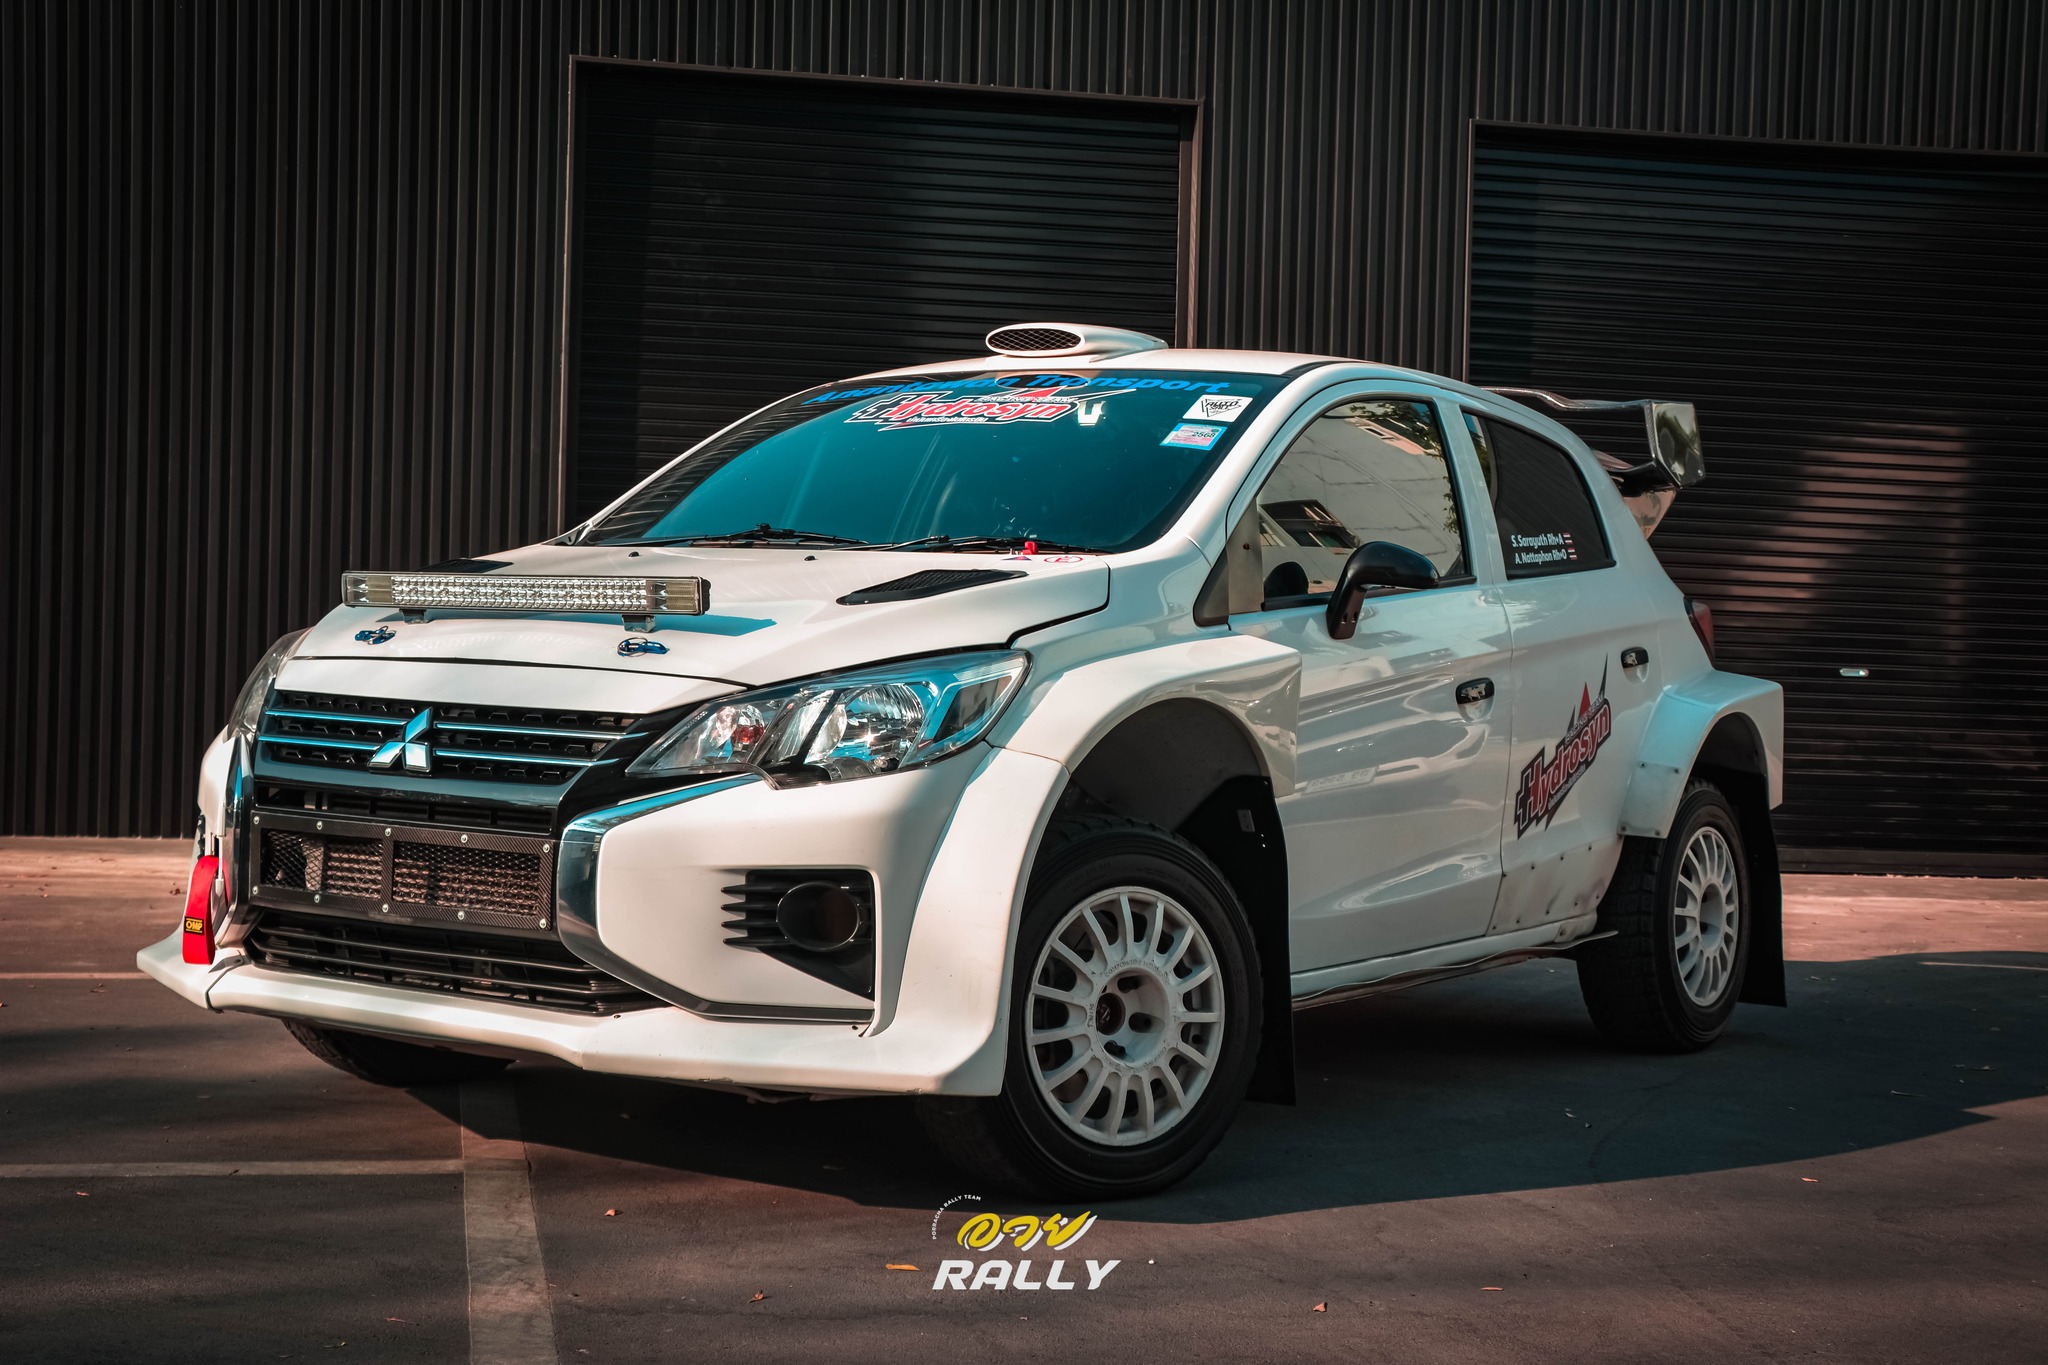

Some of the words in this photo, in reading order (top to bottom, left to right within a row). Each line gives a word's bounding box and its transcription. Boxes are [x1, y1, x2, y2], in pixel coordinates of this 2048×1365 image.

[1028, 374, 1231, 393] Transport
[864, 394, 1072, 421] Hydrosyn
[1516, 703, 1611, 831] Hydrosyn
[185, 920, 203, 931] OMP
